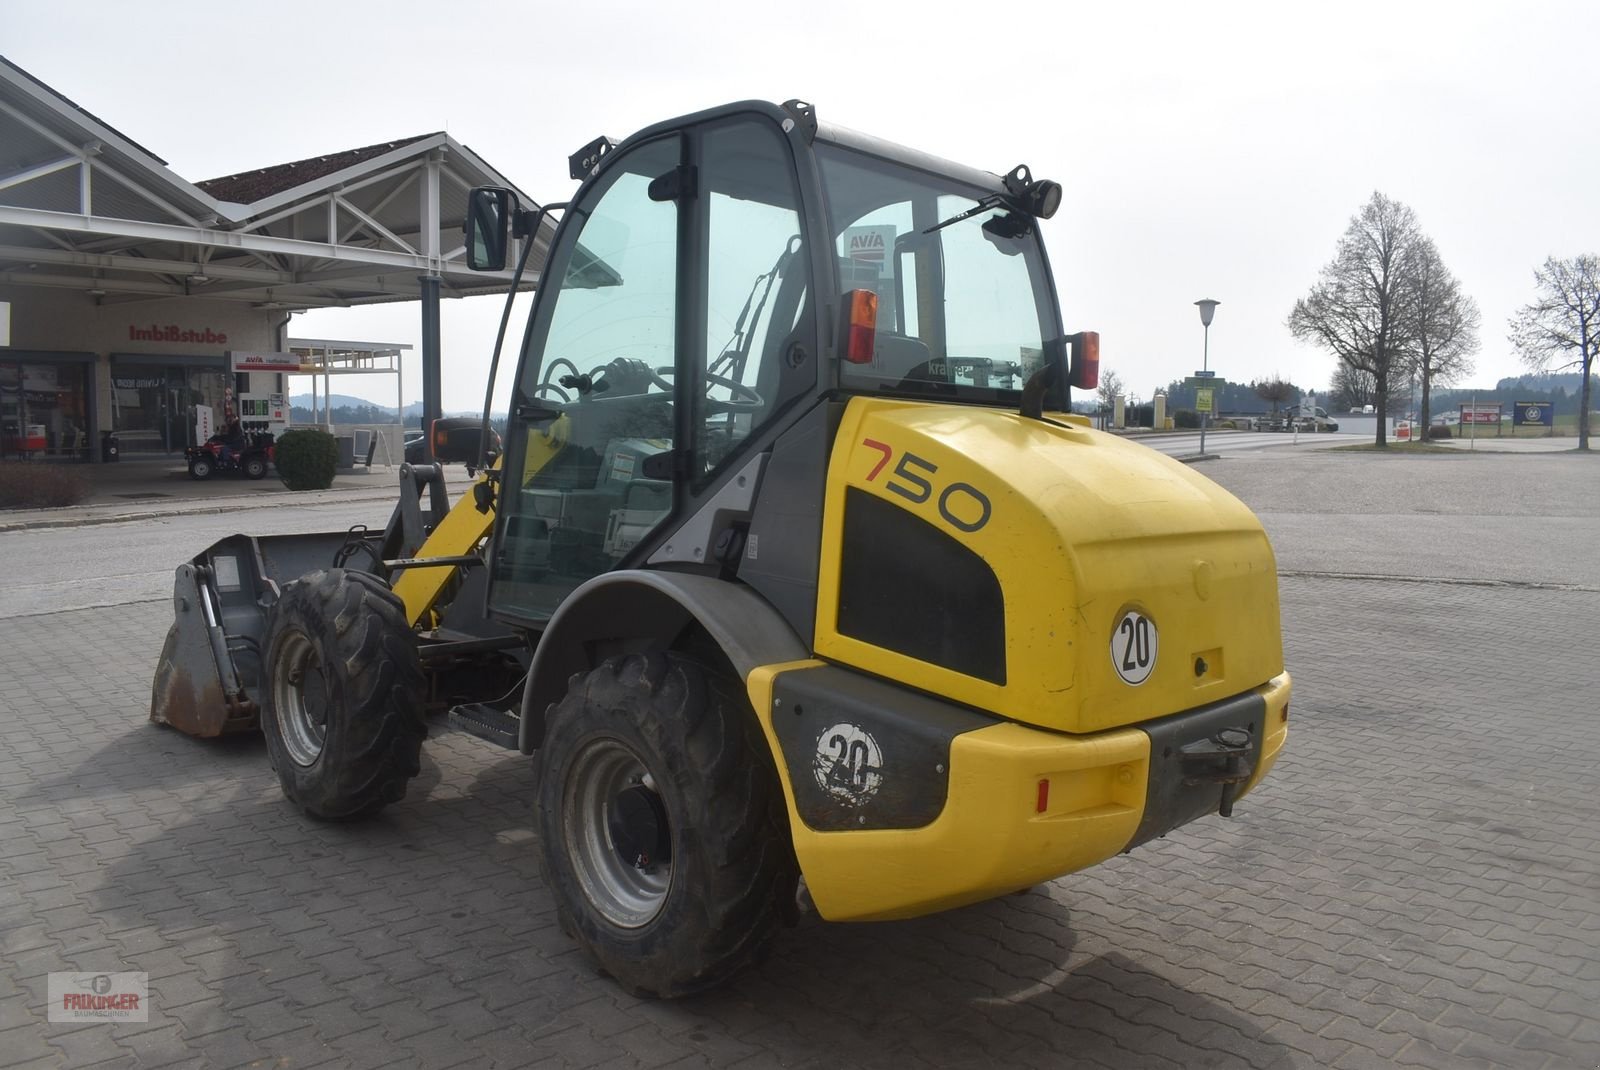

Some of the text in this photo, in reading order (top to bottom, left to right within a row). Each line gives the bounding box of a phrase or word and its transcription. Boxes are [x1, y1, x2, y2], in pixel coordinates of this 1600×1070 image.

[851, 232, 885, 248] AVIA
[129, 325, 227, 343] Imbißstube
[862, 438, 992, 532] 750
[1121, 616, 1150, 671] 20
[828, 734, 869, 793] 20
